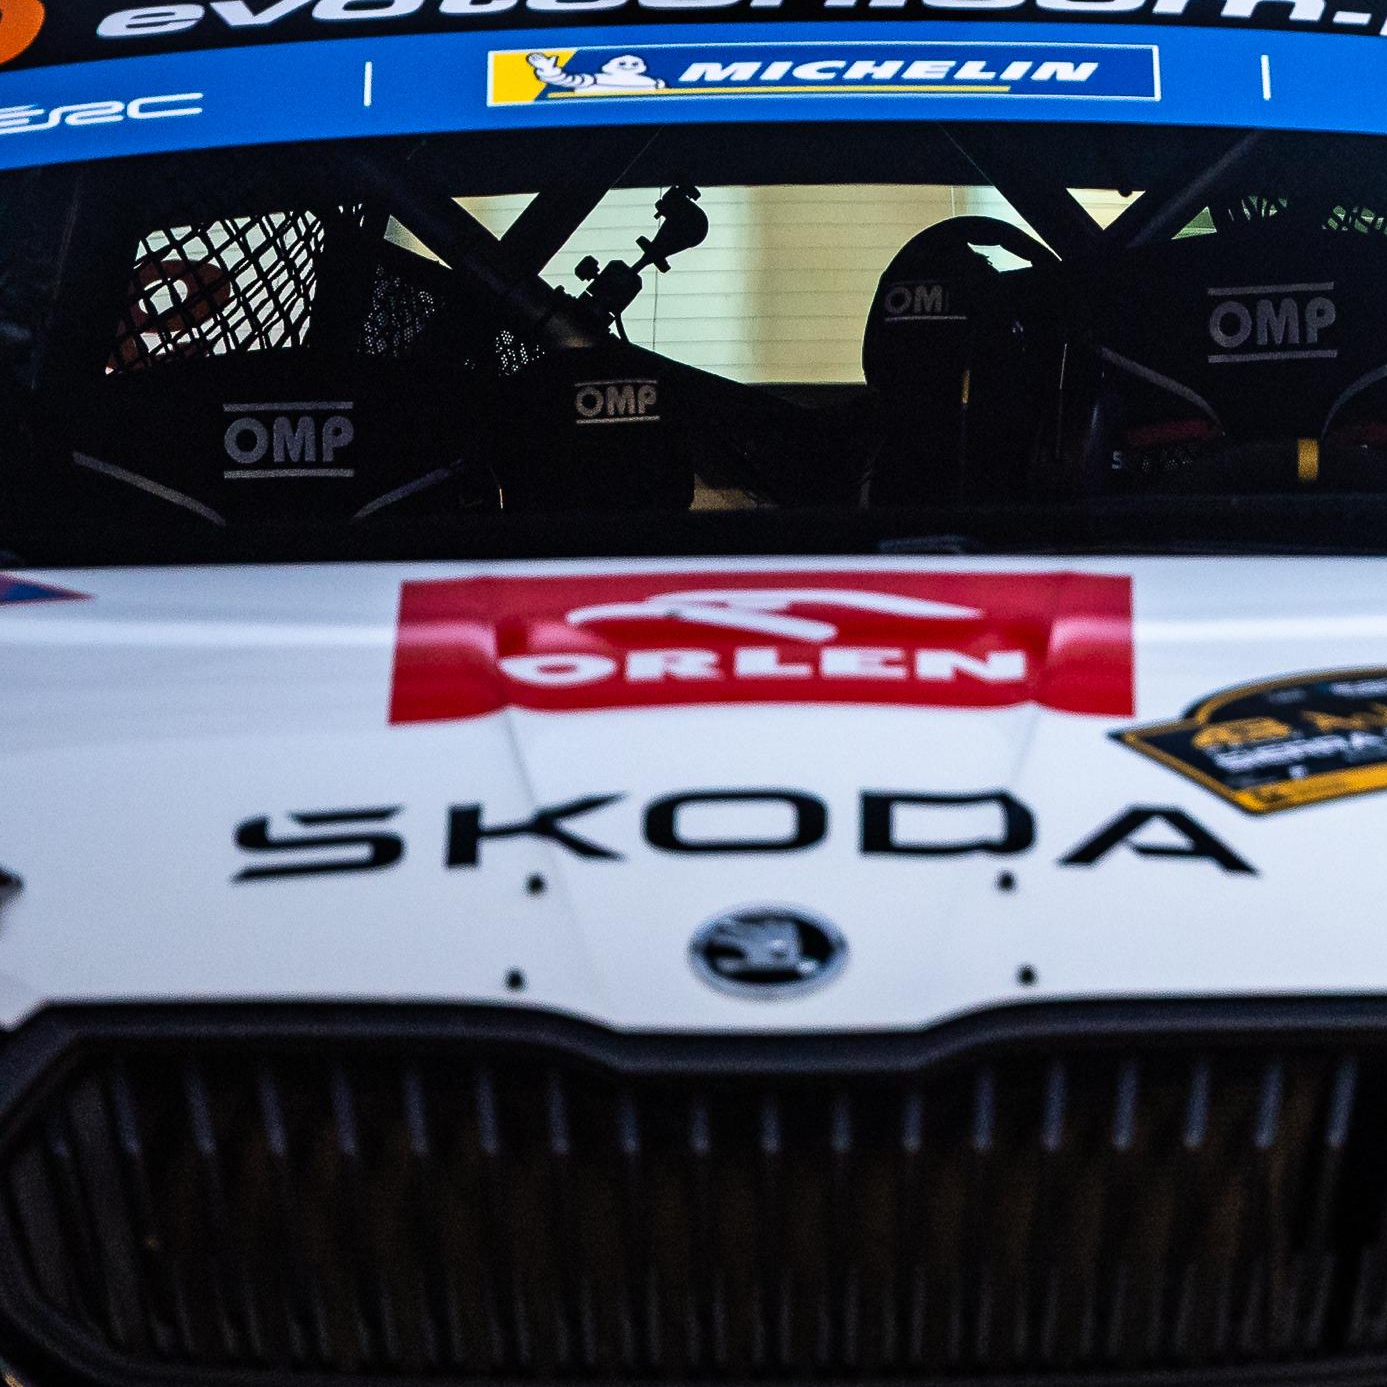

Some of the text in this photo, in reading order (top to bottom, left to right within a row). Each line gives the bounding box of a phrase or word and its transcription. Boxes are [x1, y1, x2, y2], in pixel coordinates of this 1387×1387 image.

[679, 60, 1100, 84] MICHELIN
[1209, 300, 1336, 348] OMP
[576, 386, 657, 417] OMP
[224, 416, 353, 464] OMP
[499, 645, 1026, 685] ORLEN
